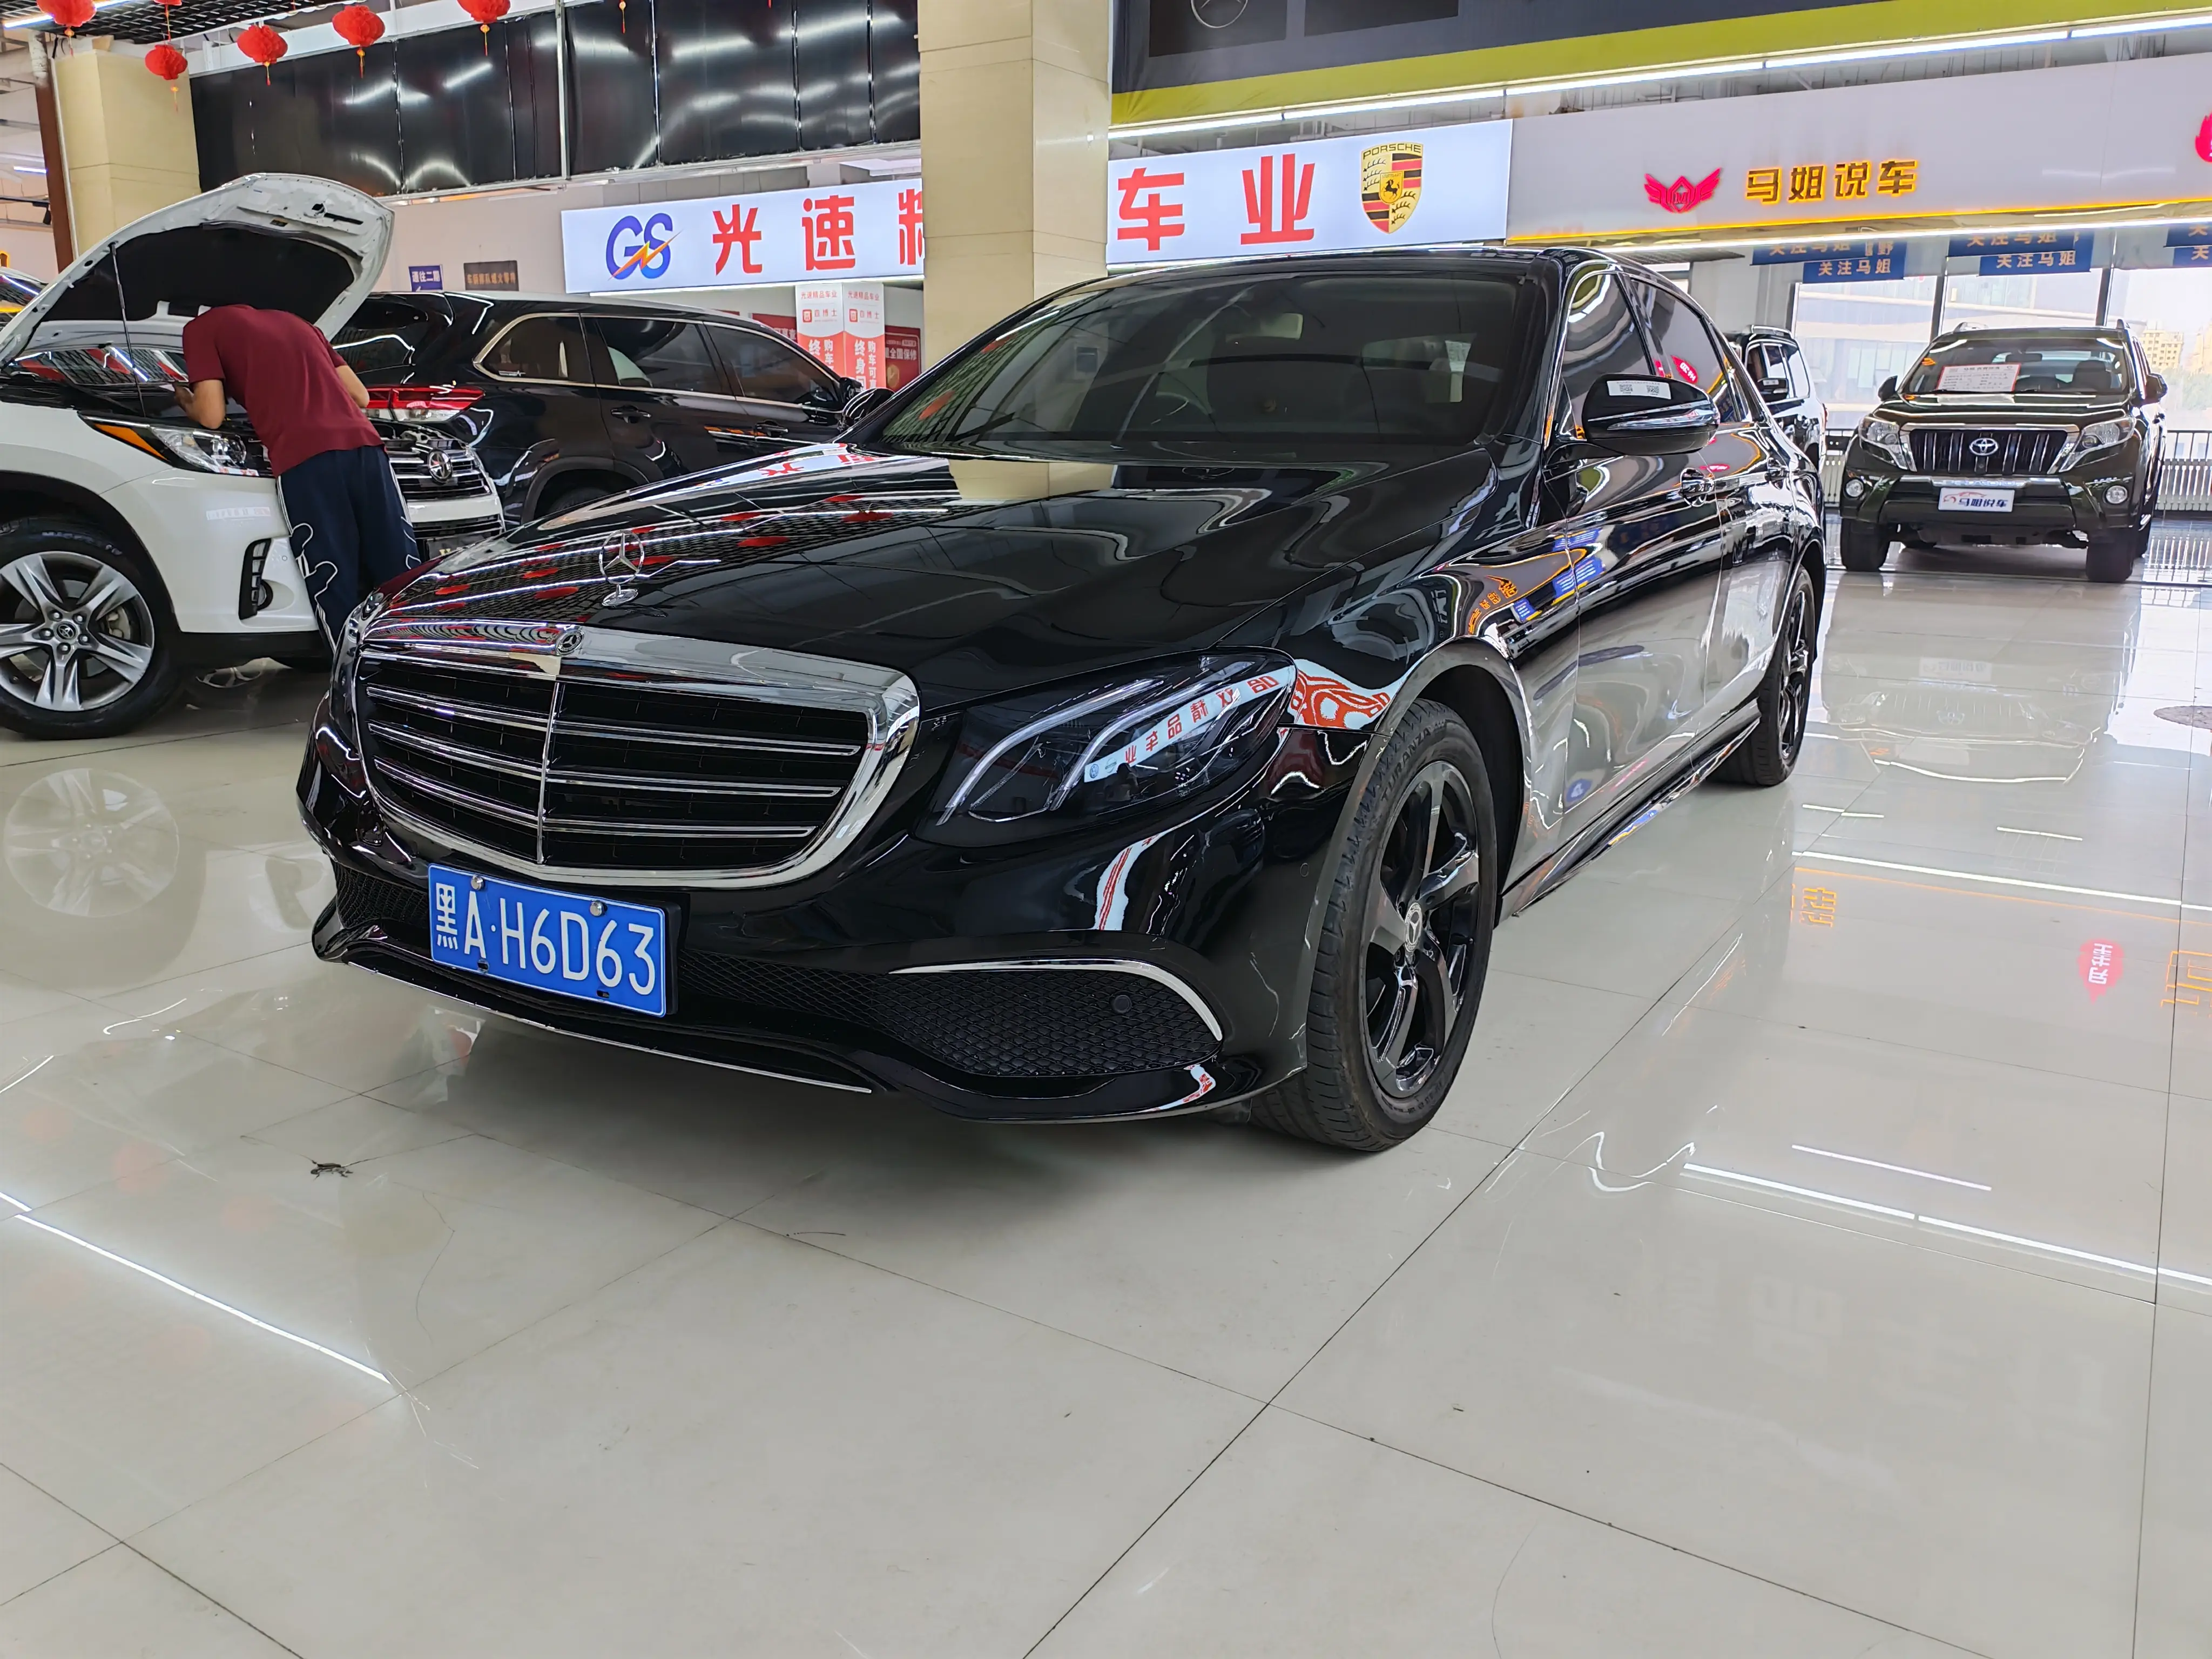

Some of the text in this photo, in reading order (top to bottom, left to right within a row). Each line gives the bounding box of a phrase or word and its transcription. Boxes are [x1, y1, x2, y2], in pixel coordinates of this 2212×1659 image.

[1363, 143, 1421, 160] PORSCHE
[1117, 153, 1316, 251] 车业
[1746, 160, 1916, 203] 马姐说车
[605, 213, 673, 280] GS
[1818, 259, 1891, 276] 关注马姐
[801, 290, 838, 299] 光速精品车业
[848, 291, 880, 301] 光速精品车业
[1380, 727, 1431, 802] TURANZA
[435, 882, 656, 996] 黑A·H6D63
